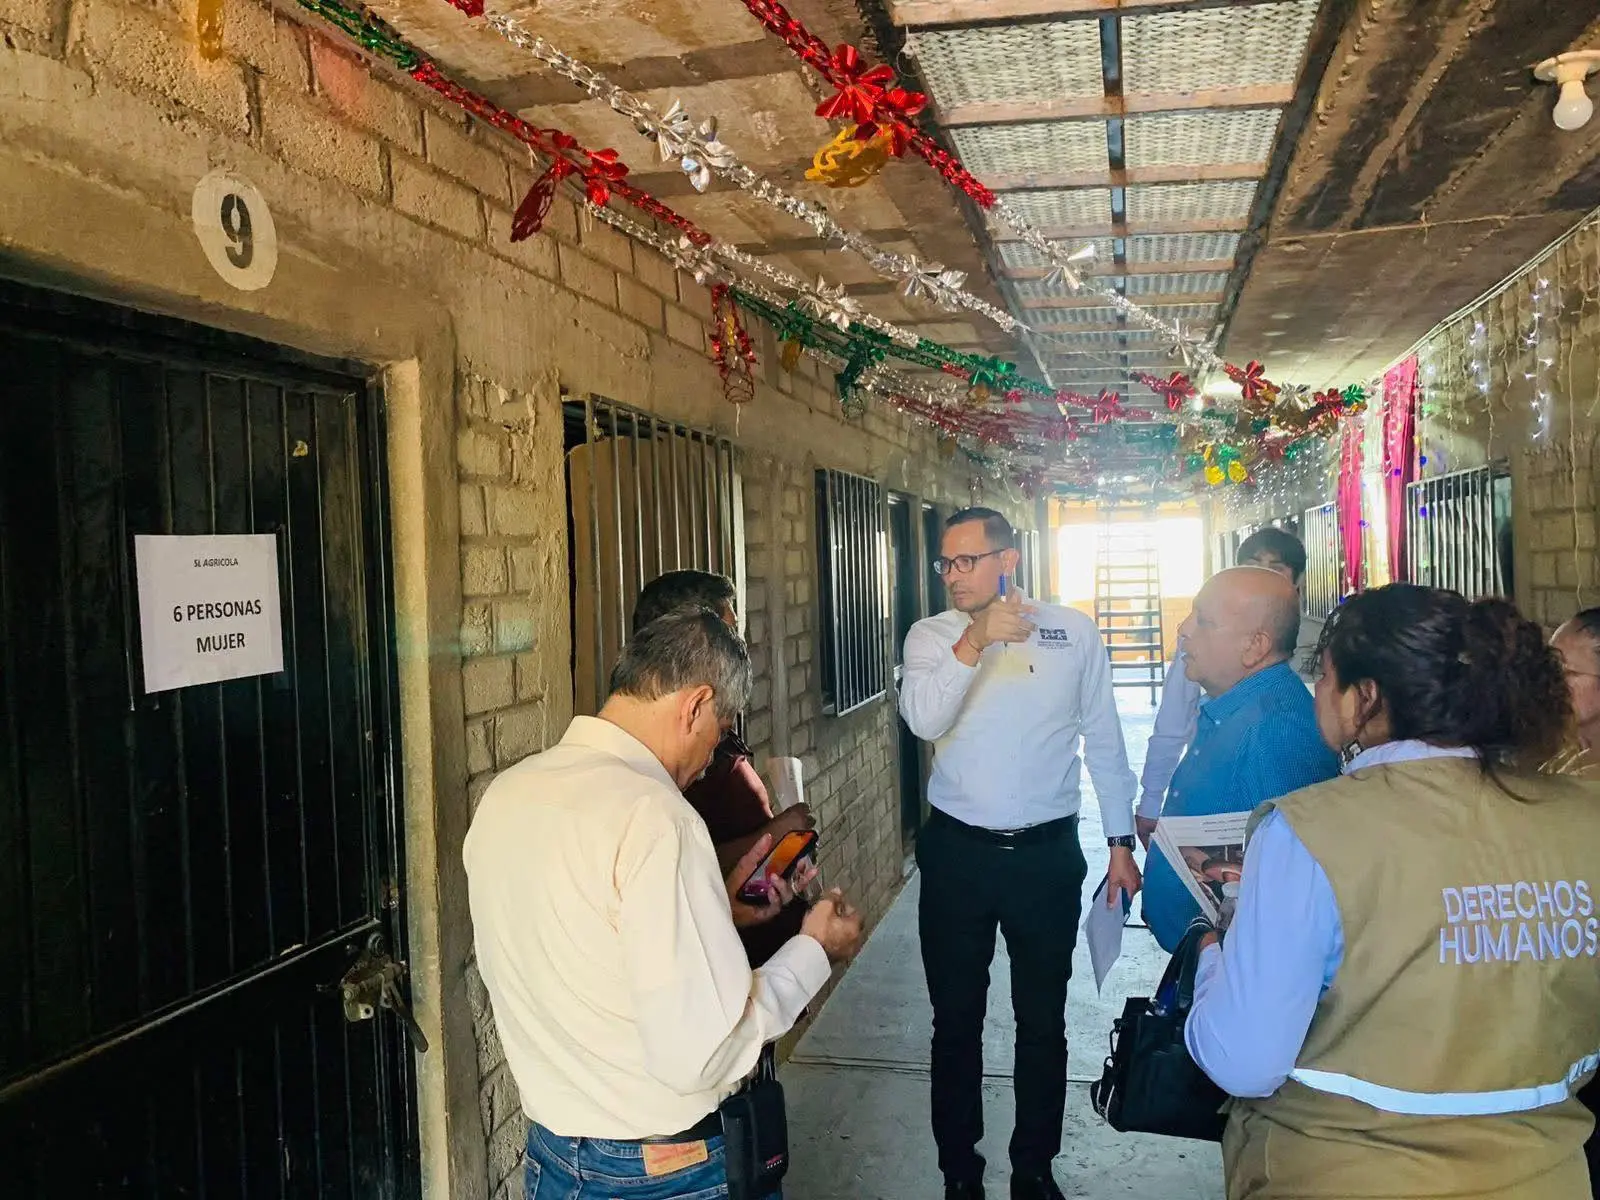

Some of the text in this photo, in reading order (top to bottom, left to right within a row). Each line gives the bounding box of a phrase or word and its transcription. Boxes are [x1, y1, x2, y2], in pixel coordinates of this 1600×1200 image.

[220, 193, 253, 269] 9
[203, 558, 239, 567] AGRICOLA
[173, 599, 262, 622] 6 PERSONAS
[196, 632, 246, 653] MUJER
[1442, 880, 1594, 923] DERECHOS
[1439, 917, 1599, 965] HUMANOS
